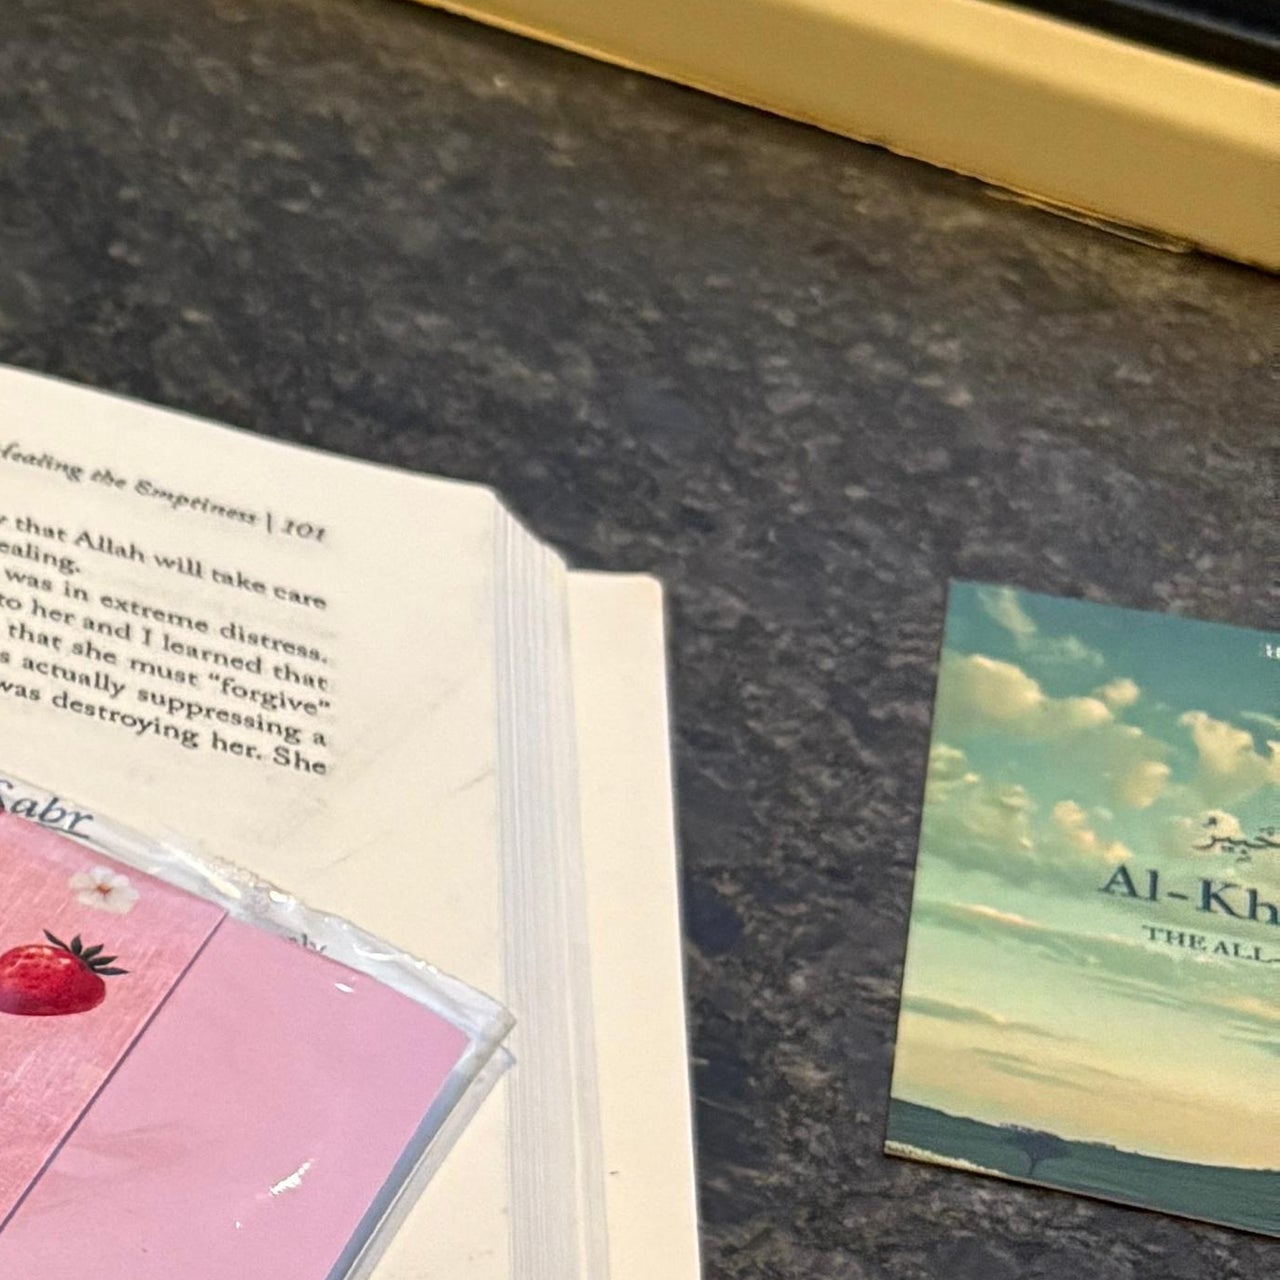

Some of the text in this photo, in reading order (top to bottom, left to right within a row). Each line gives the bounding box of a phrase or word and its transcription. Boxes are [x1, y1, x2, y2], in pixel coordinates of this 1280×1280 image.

[91, 469, 127, 488] the
[135, 480, 257, 524] Emptiness
[285, 520, 325, 541] 101
[15, 517, 66, 542] that
[74, 530, 145, 563] Allah
[154, 555, 202, 579] will
[212, 569, 266, 593] take
[273, 587, 327, 608] care
[8, 622, 62, 651] that
[72, 640, 117, 665] she
[130, 658, 198, 686] must
[208, 672, 331, 716] “forgive”
[1141, 924, 1208, 953] THE
